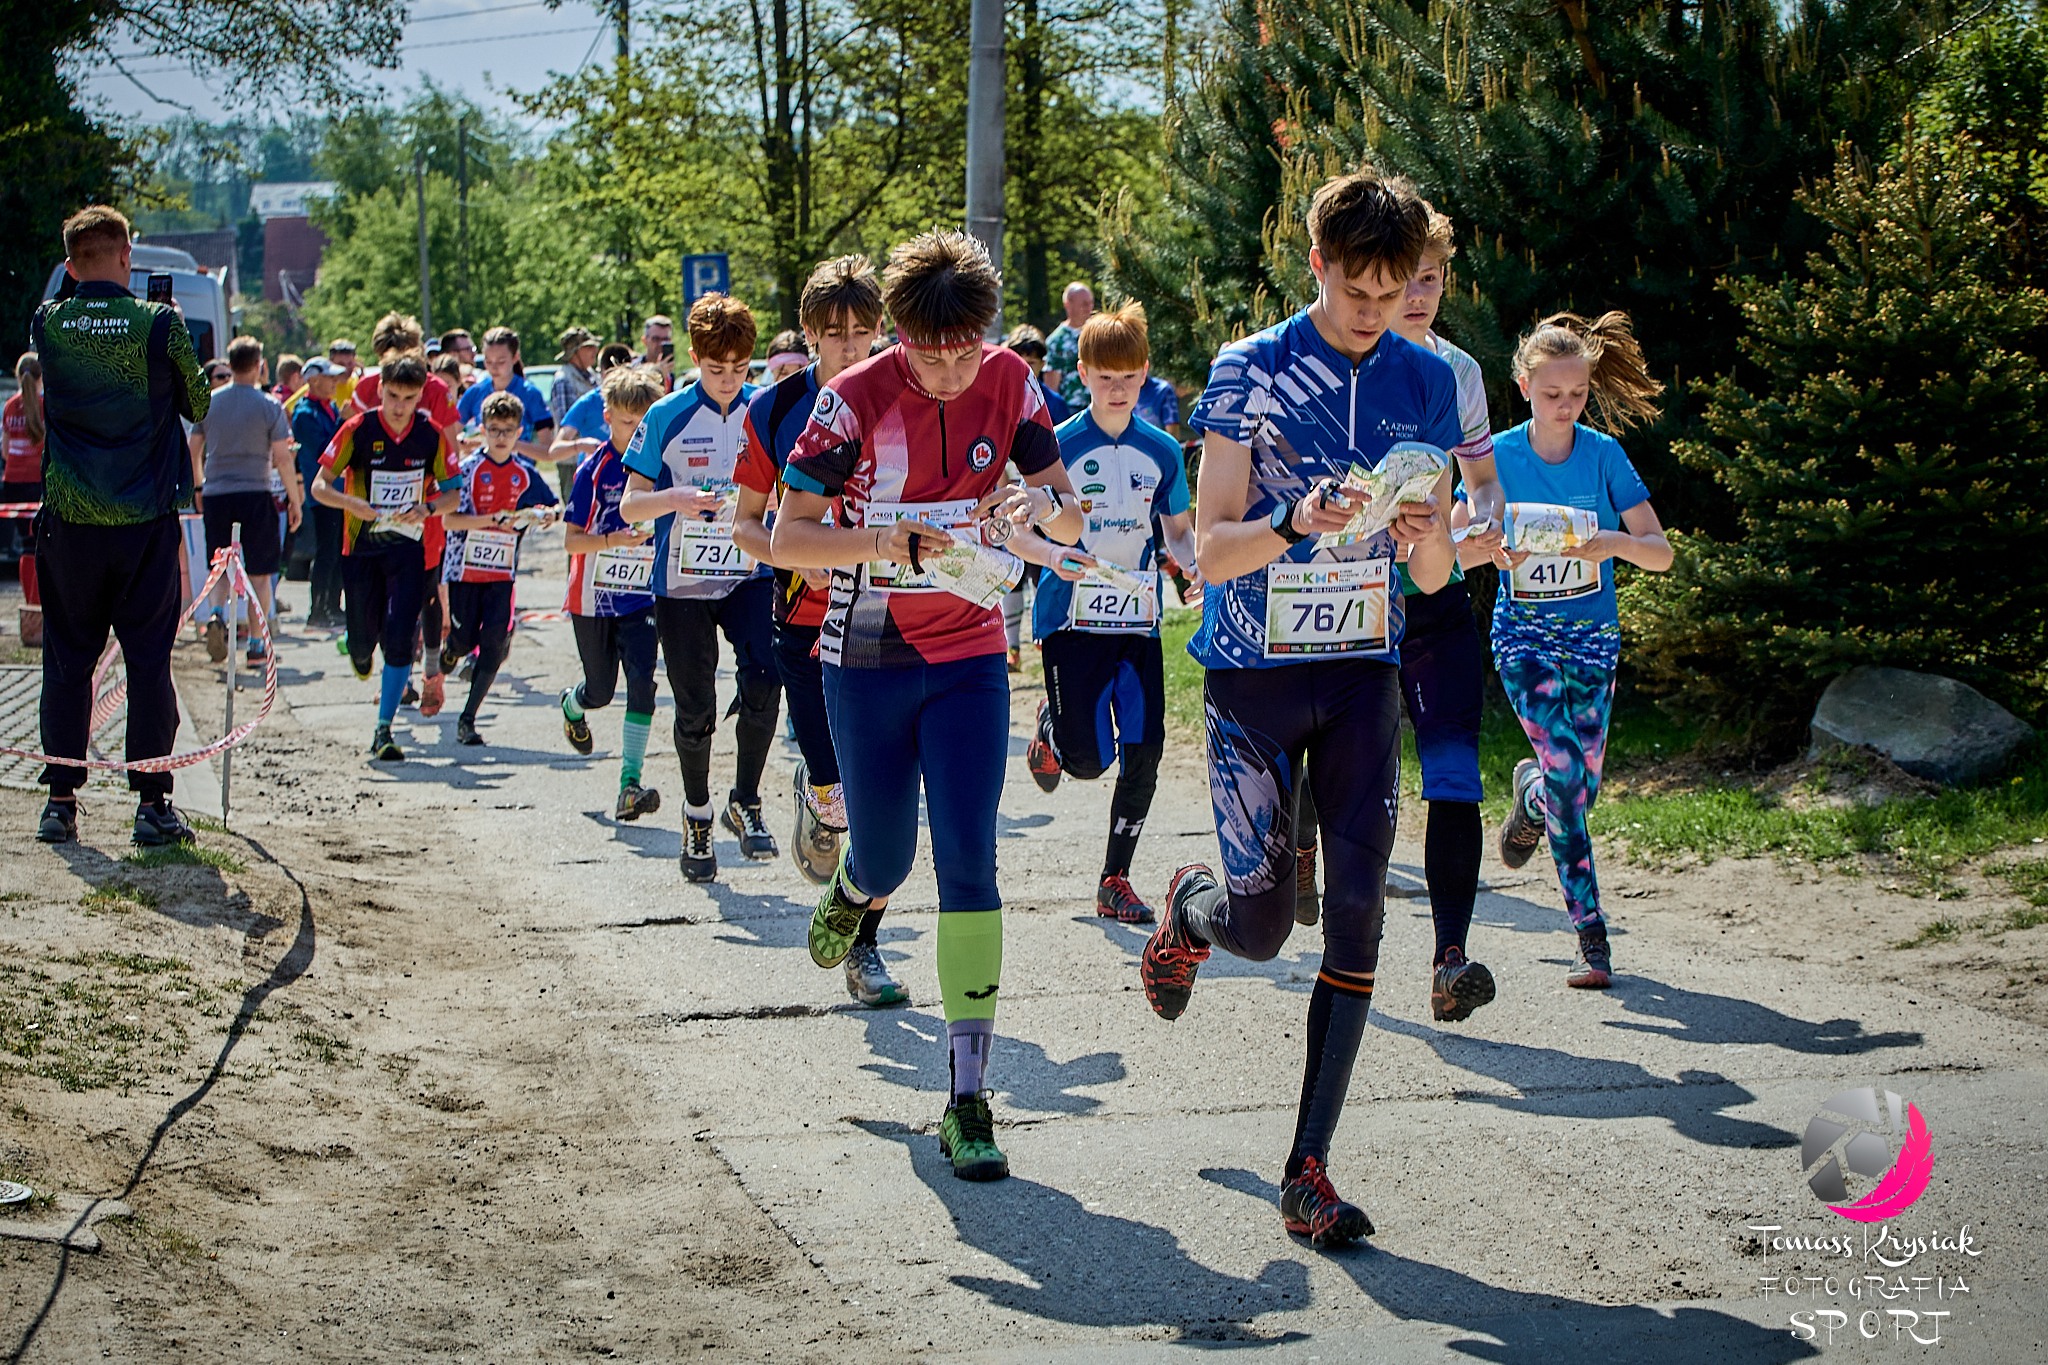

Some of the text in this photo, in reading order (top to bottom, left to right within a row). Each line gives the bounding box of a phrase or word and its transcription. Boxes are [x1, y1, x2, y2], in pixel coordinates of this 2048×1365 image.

[693, 260, 719, 297] P
[382, 486, 414, 501] 72/1
[473, 545, 506, 562] 52/1
[695, 544, 742, 565] 73/1
[605, 563, 645, 581] 46/1
[1529, 559, 1582, 585] 41/1
[1088, 594, 1139, 617] 42/1
[1292, 598, 1365, 635] 76/1
